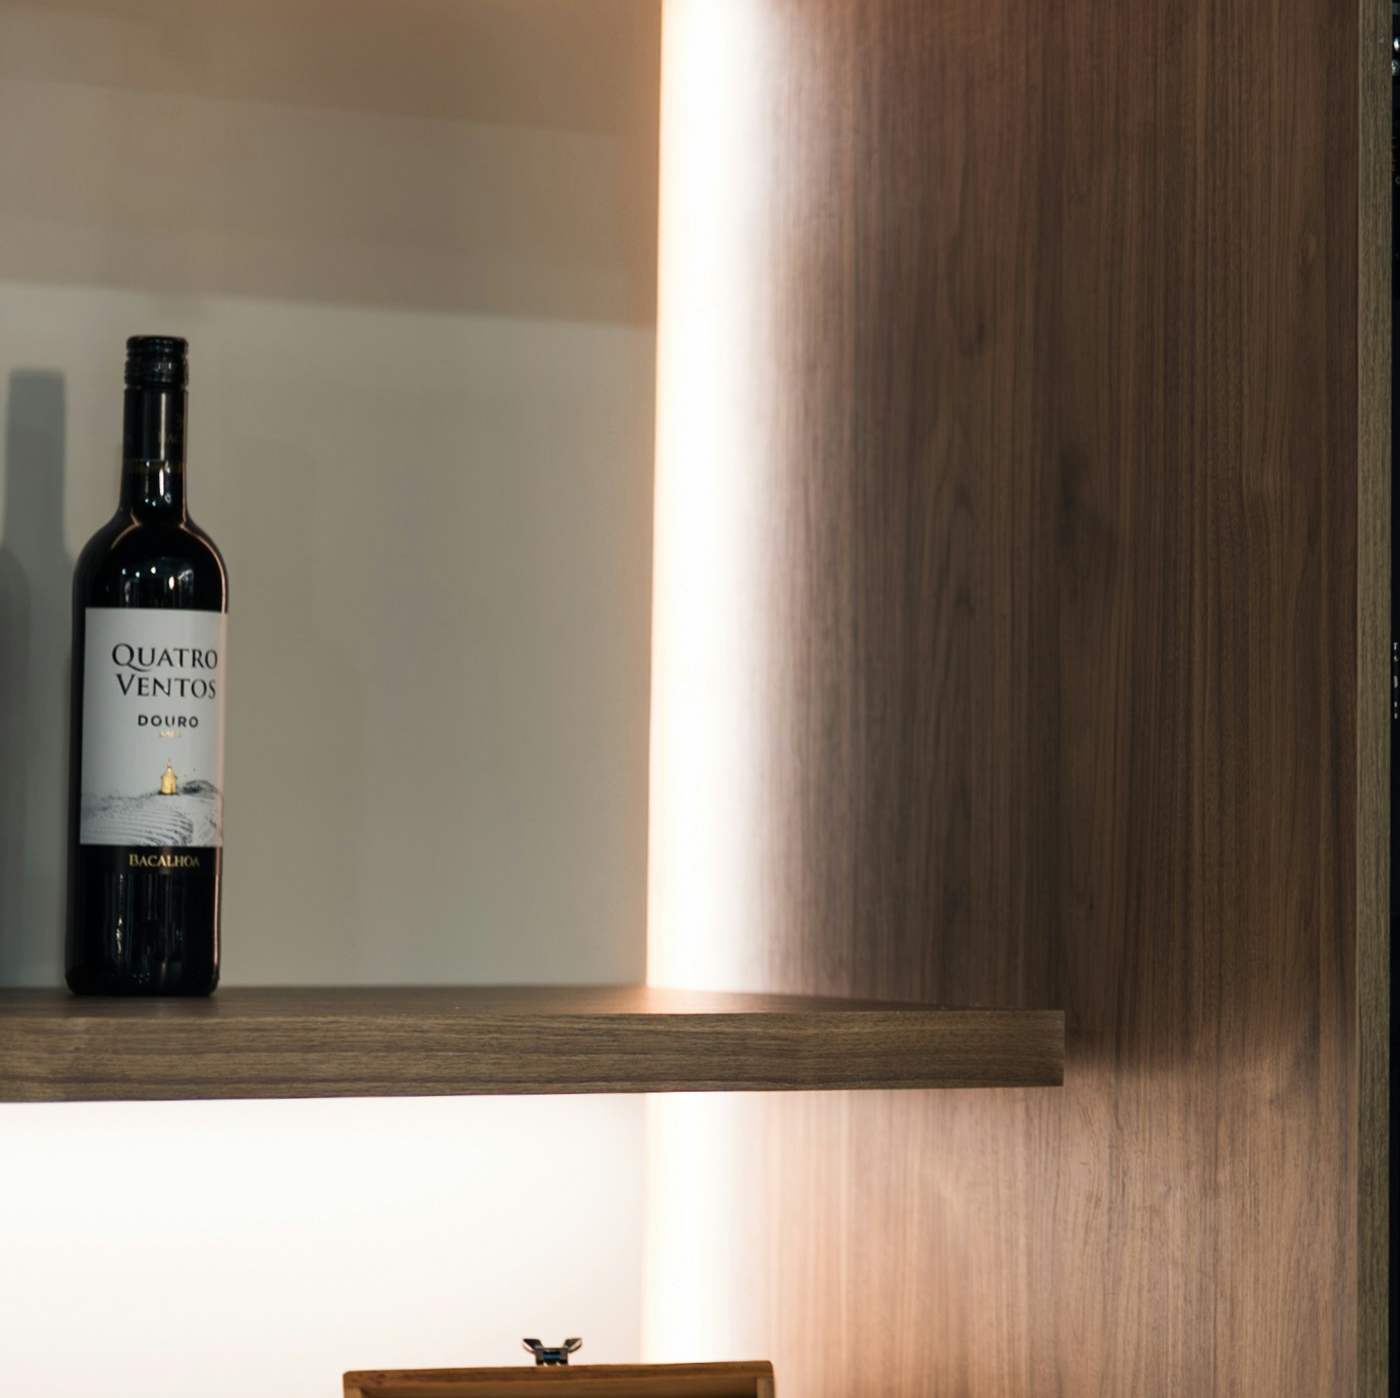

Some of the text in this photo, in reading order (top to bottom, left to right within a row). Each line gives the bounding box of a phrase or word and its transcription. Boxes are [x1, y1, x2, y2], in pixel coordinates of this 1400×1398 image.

[112, 643, 218, 672] QUATRO
[115, 673, 216, 700] VENTOS
[137, 714, 199, 728] DOURO
